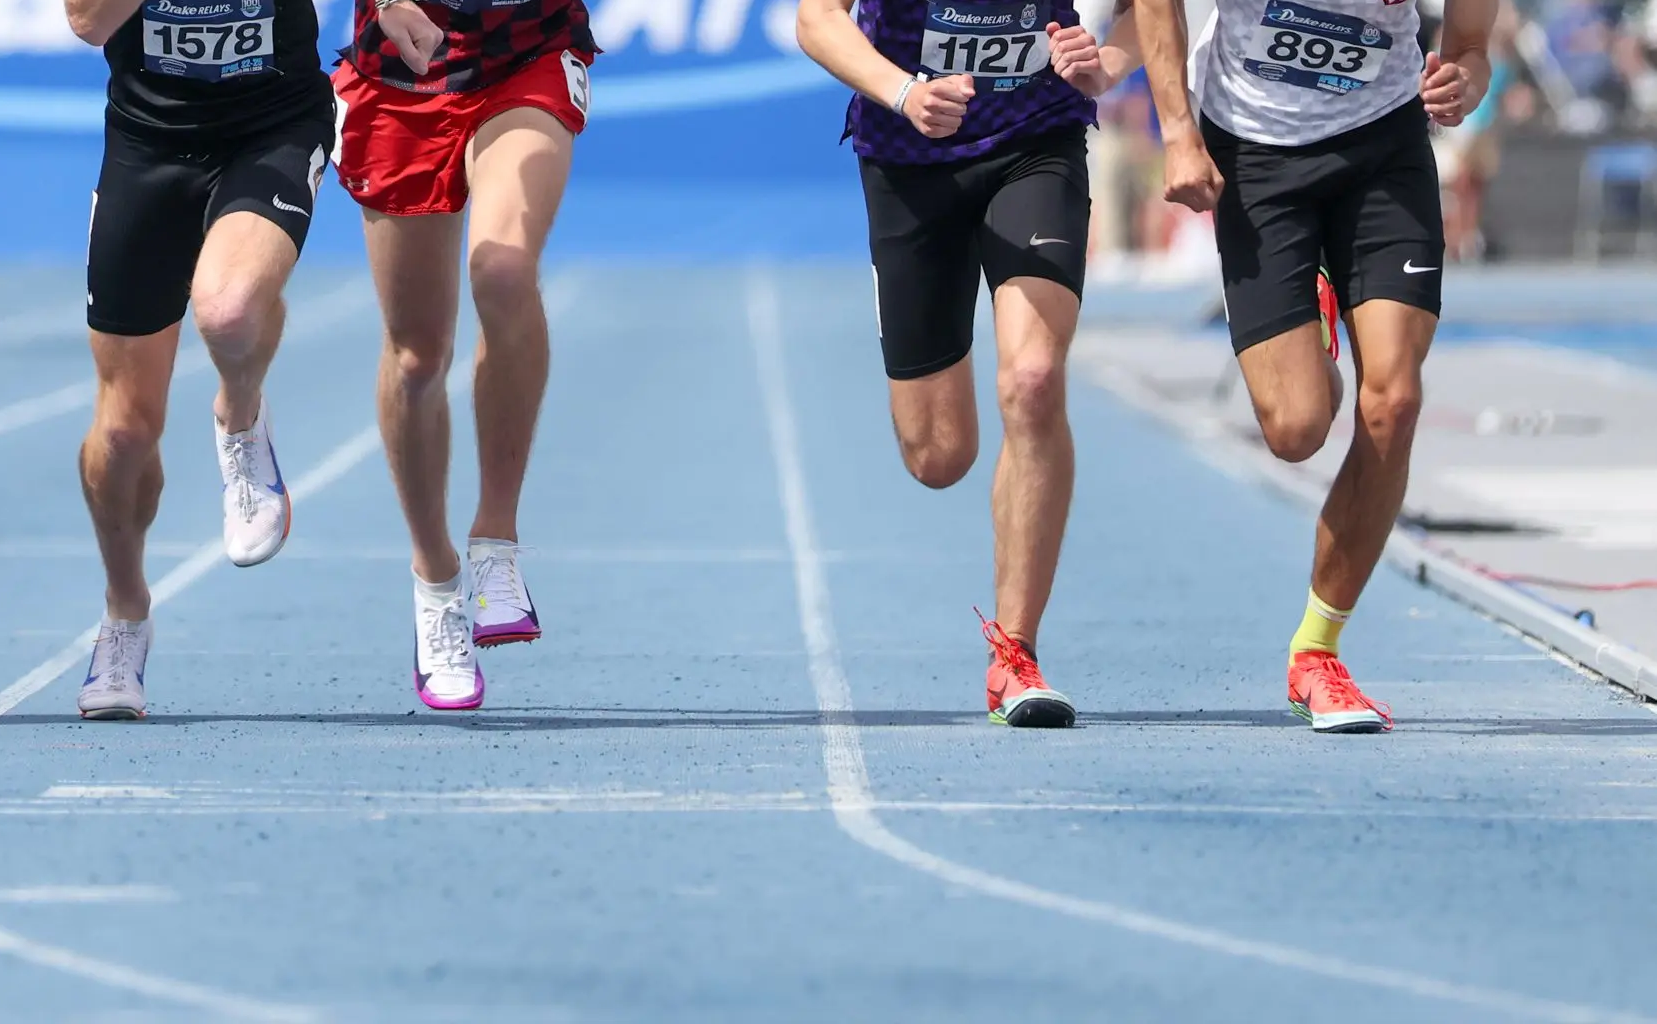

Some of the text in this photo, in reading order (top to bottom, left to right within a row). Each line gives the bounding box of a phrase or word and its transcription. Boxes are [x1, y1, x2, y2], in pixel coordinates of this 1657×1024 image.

[157, 0, 231, 16] Drake RELAYS
[942, 7, 1012, 25] Drake RELAYS
[1280, 8, 1353, 34] Drake RELAYS
[153, 22, 263, 61] 1578
[938, 34, 1036, 73] 1127
[1266, 30, 1368, 73] 893
